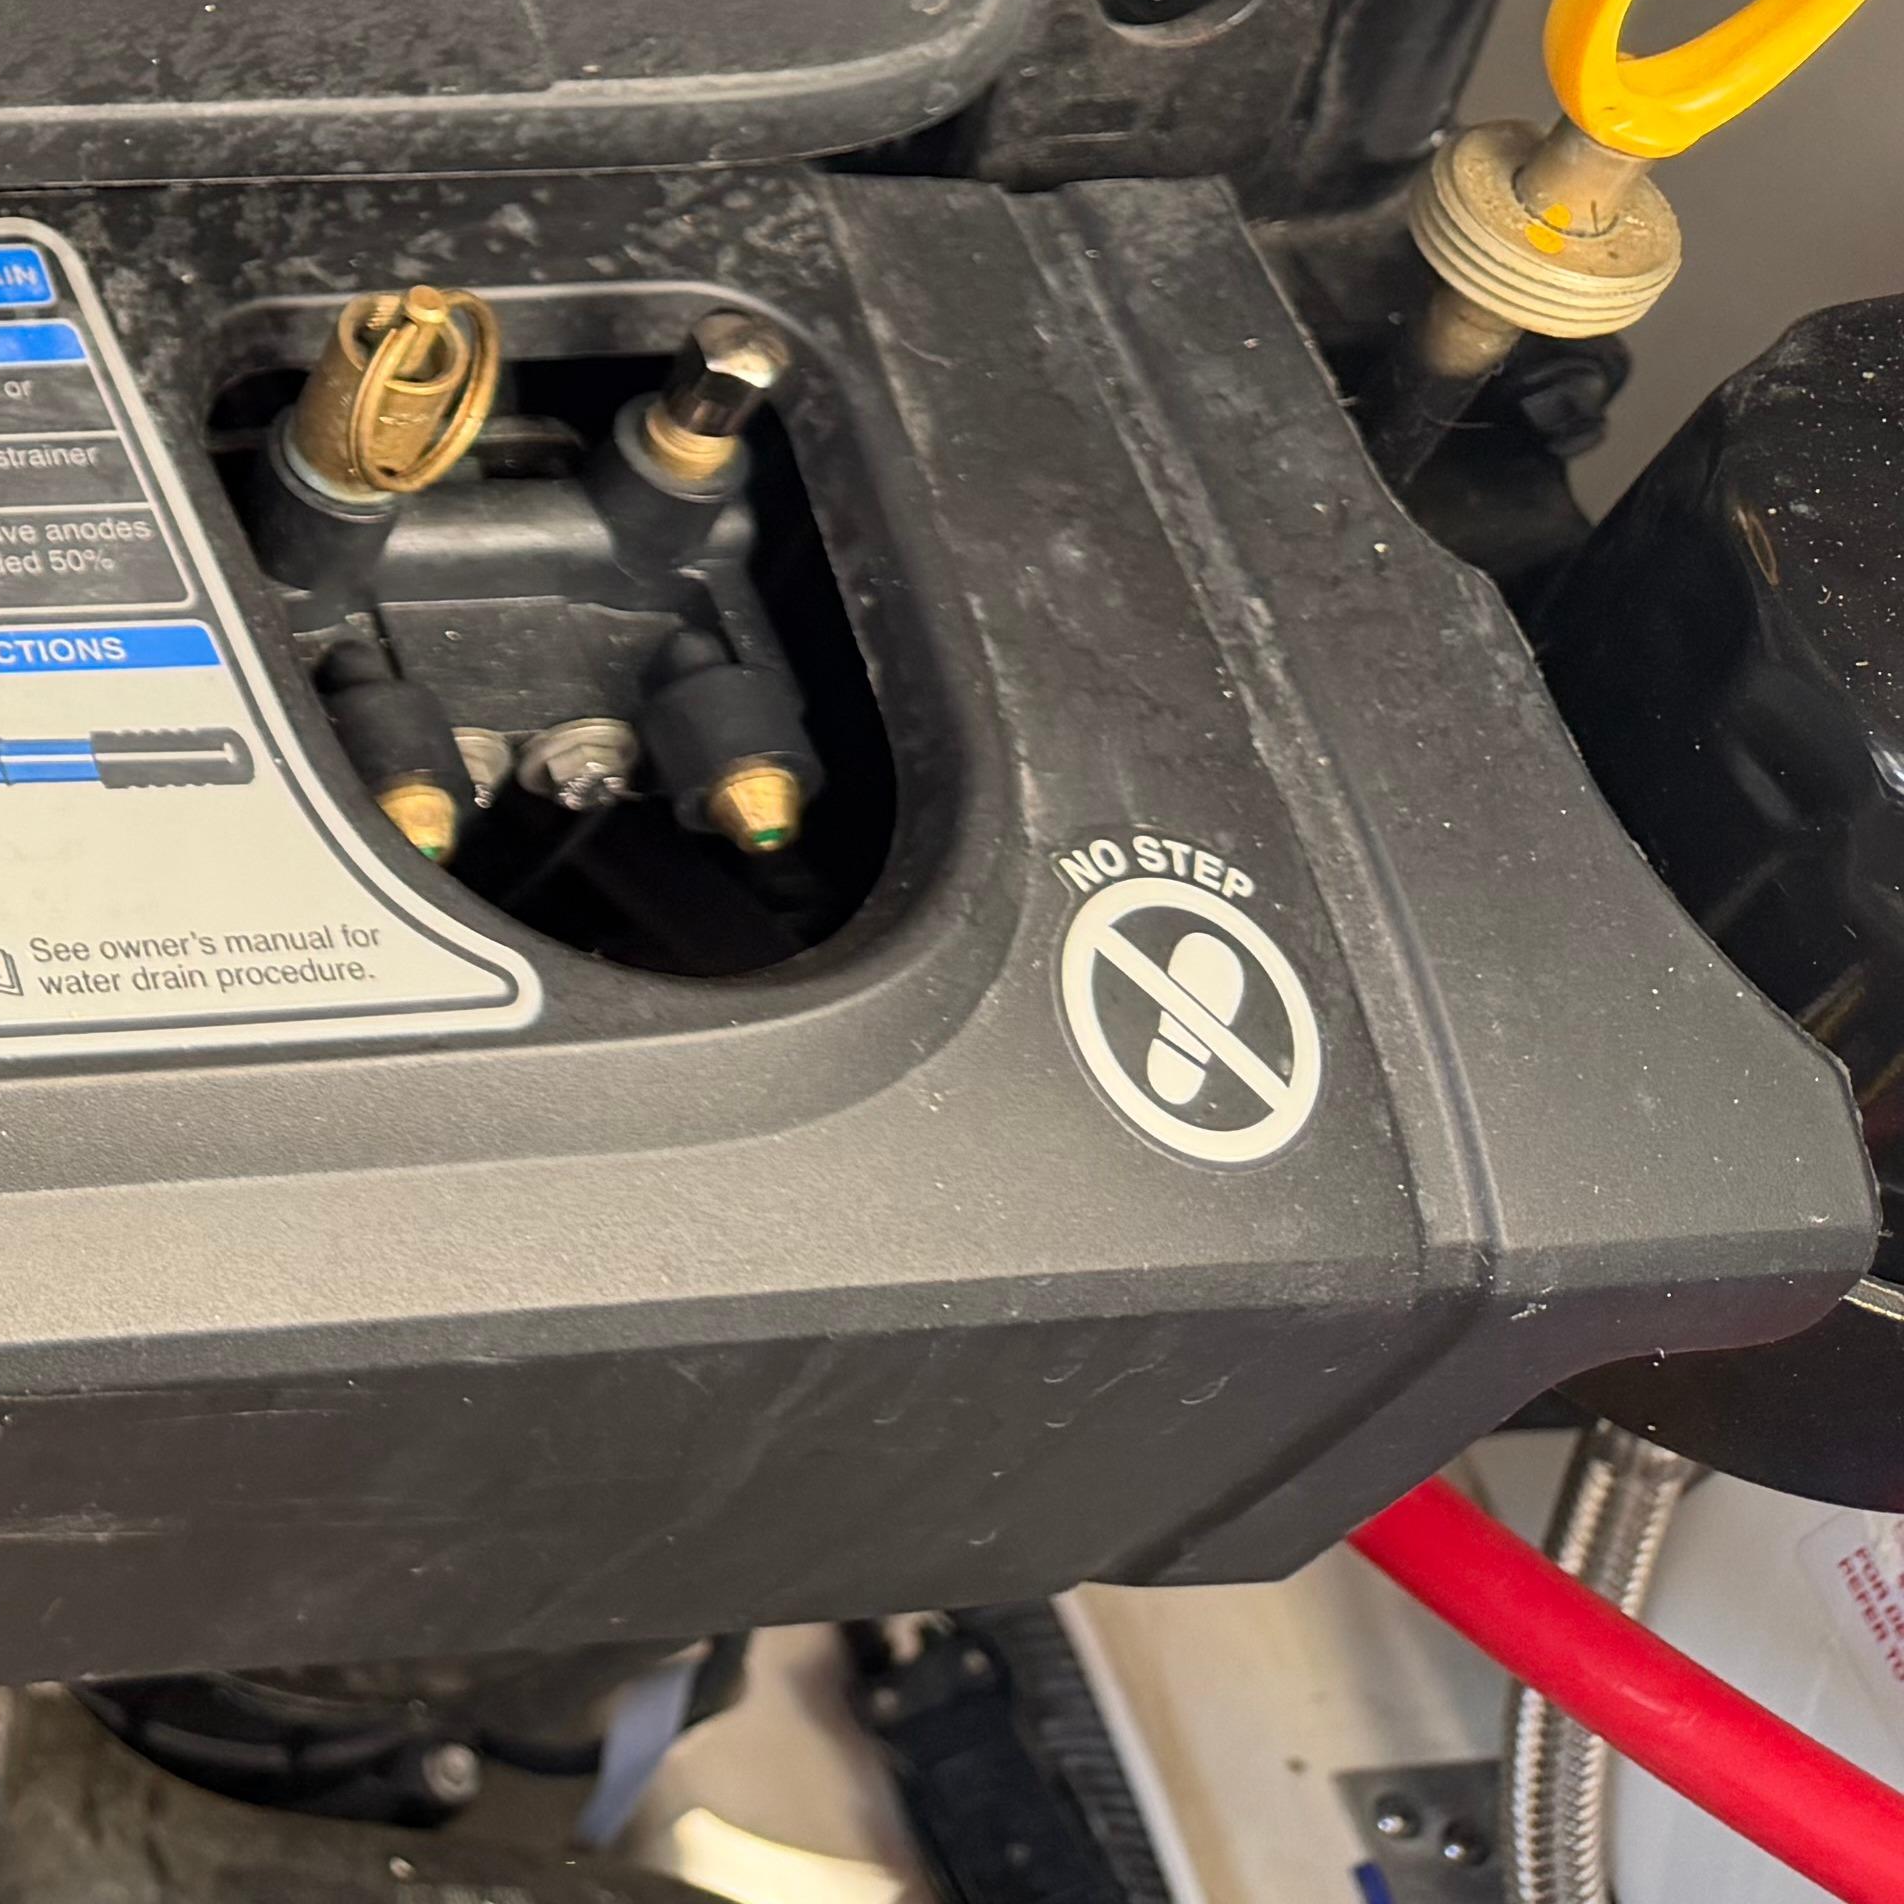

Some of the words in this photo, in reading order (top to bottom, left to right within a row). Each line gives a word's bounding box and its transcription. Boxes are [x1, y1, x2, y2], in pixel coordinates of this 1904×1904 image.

[3, 379, 31, 400] or
[1059, 839, 1128, 893] NO
[1132, 834, 1256, 898] STEP
[28, 936, 92, 964] See
[98, 930, 218, 962] owner's
[223, 923, 336, 955] manual
[340, 922, 380, 949] for
[37, 969, 122, 996] water
[130, 962, 210, 992] drain
[214, 956, 376, 995] procedure.
